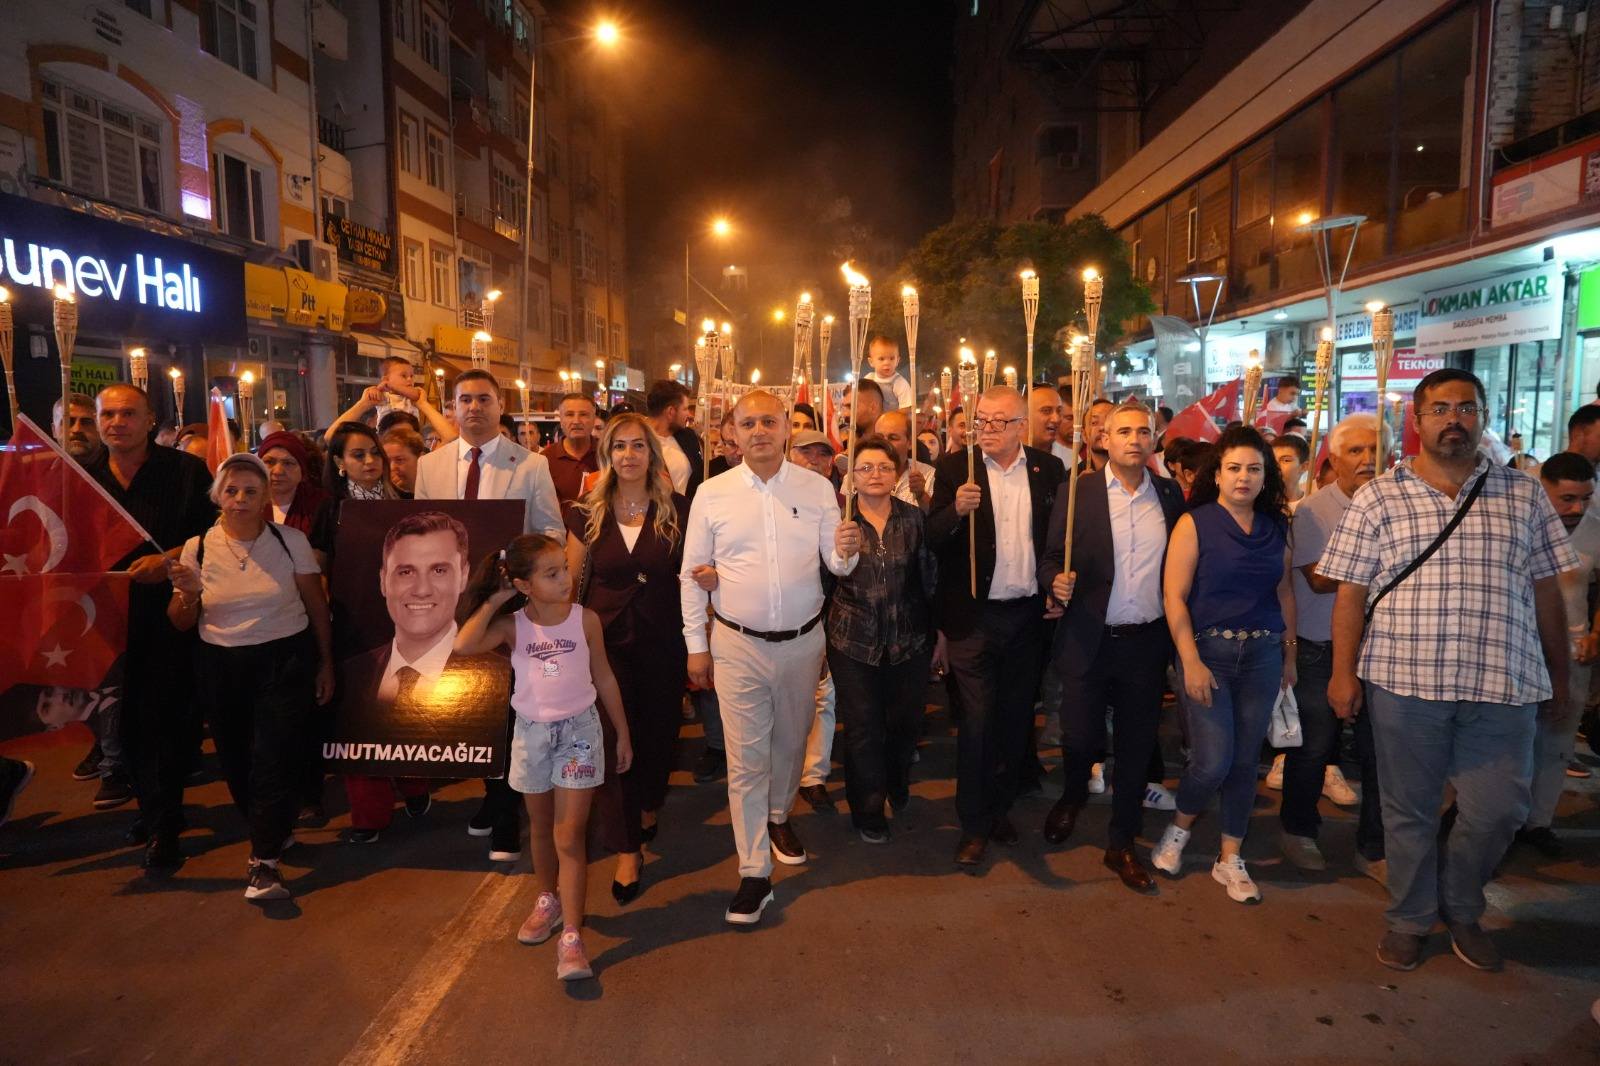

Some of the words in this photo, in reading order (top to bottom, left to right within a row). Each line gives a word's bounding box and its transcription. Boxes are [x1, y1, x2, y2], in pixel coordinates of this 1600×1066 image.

[0, 238, 127, 301] unev
[136, 253, 201, 313] Halı
[1421, 287, 1482, 318] LOKMAN
[1487, 275, 1548, 303] AKTAR
[1344, 317, 1372, 340] BELEDİY
[1393, 310, 1418, 332] CARET
[525, 641, 553, 654] Hello
[553, 638, 577, 652] Kitty
[322, 741, 493, 764] UNUTMAYACAĞIZ!
